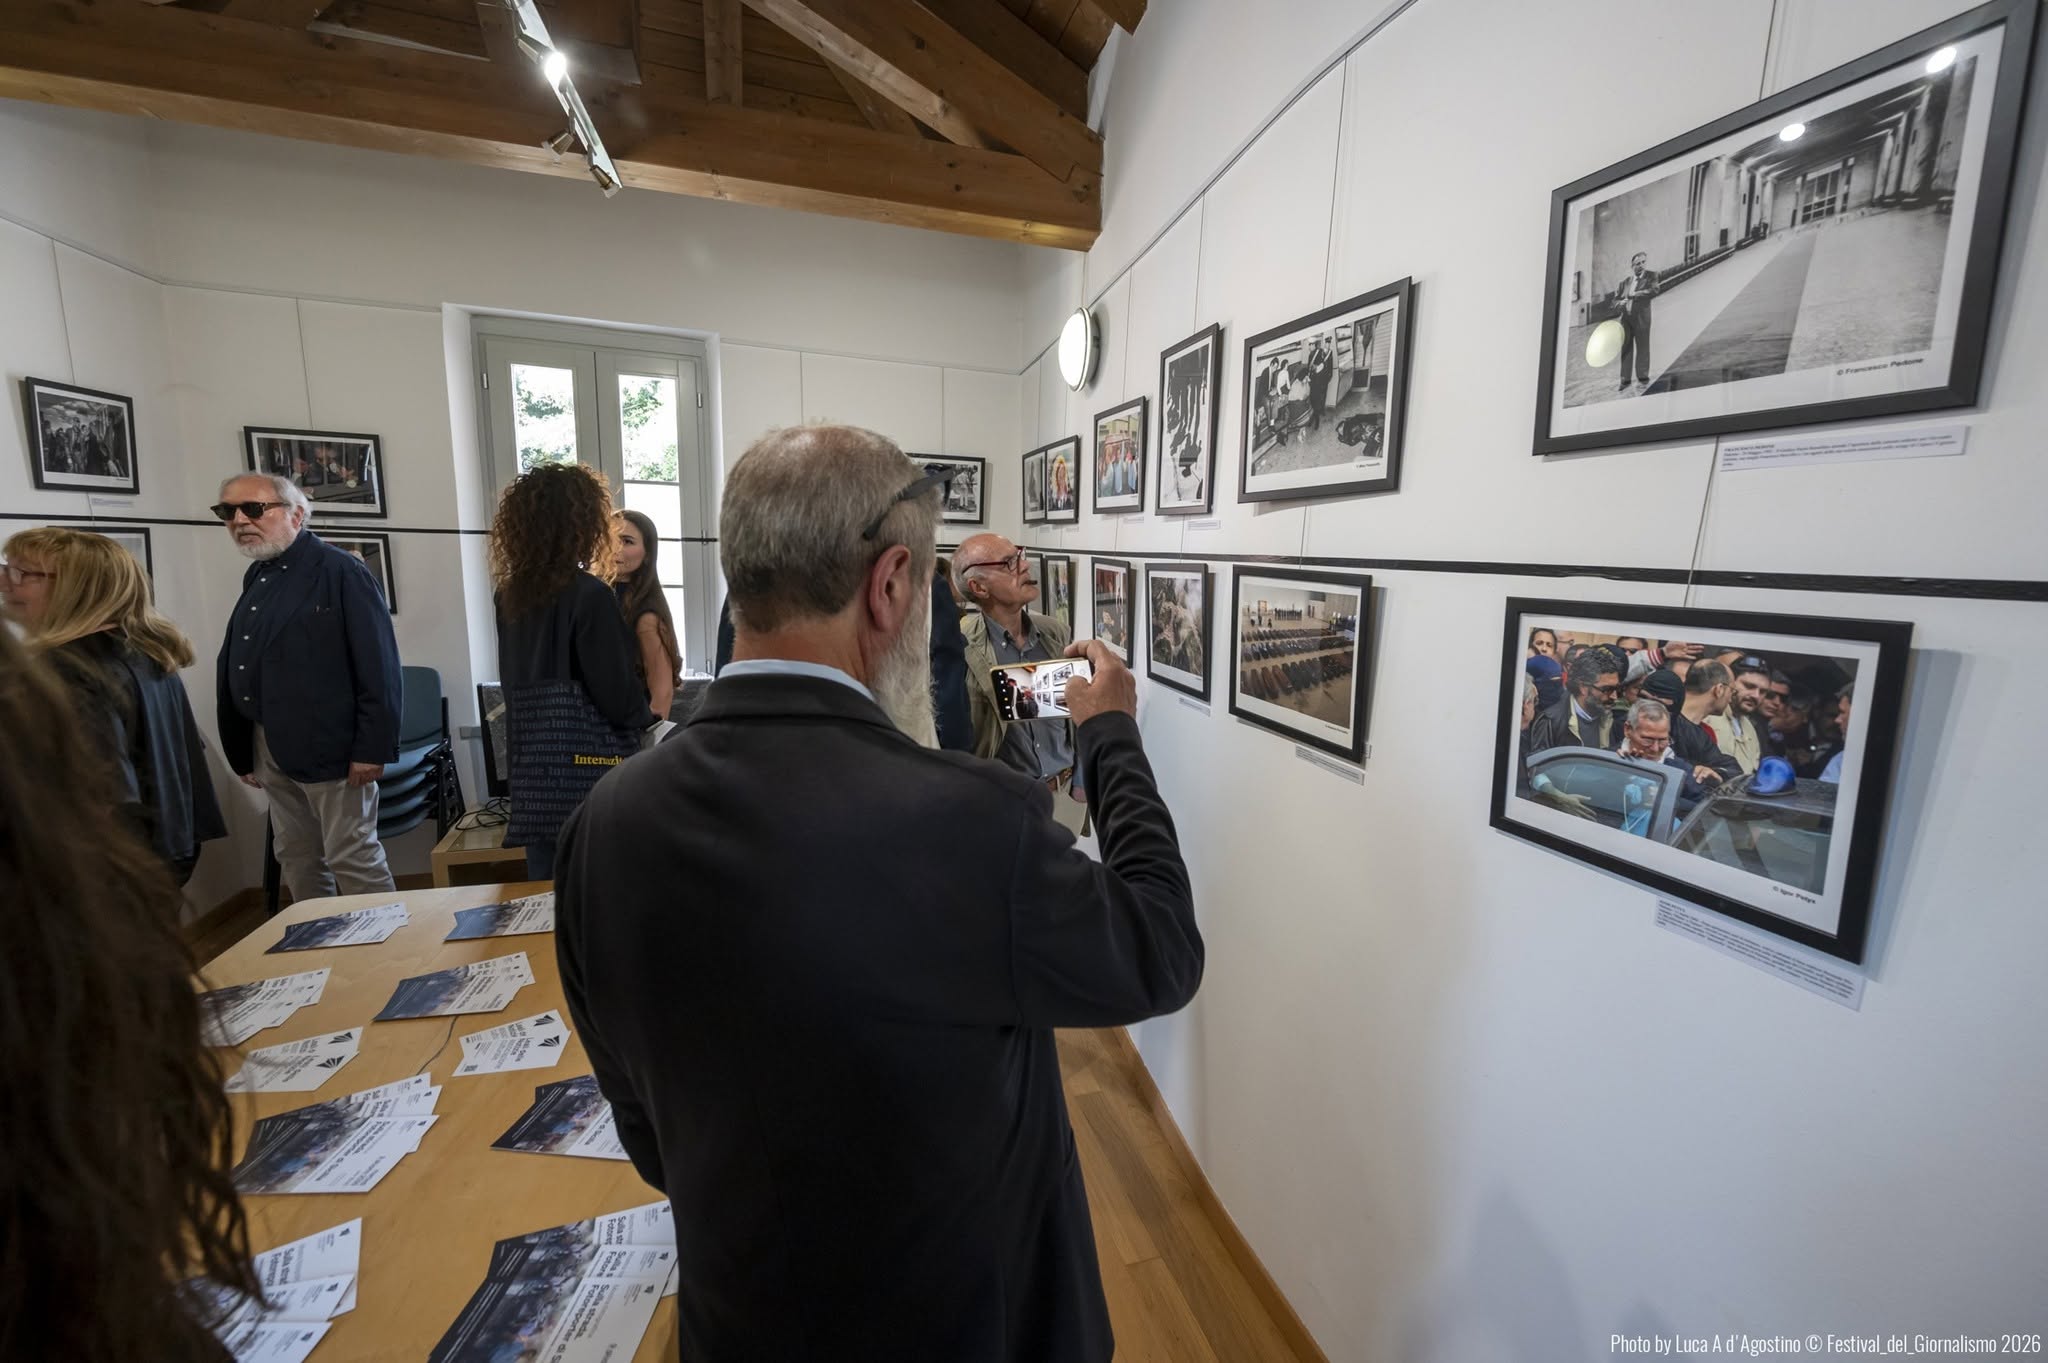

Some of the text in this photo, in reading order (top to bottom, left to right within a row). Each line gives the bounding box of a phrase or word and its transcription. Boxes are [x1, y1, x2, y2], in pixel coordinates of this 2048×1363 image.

[1845, 362, 1889, 375] Francesco
[610, 1251, 627, 1272] Sulla
[592, 1284, 610, 1306] Sulla
[564, 1285, 600, 1342] Fotoreporter
